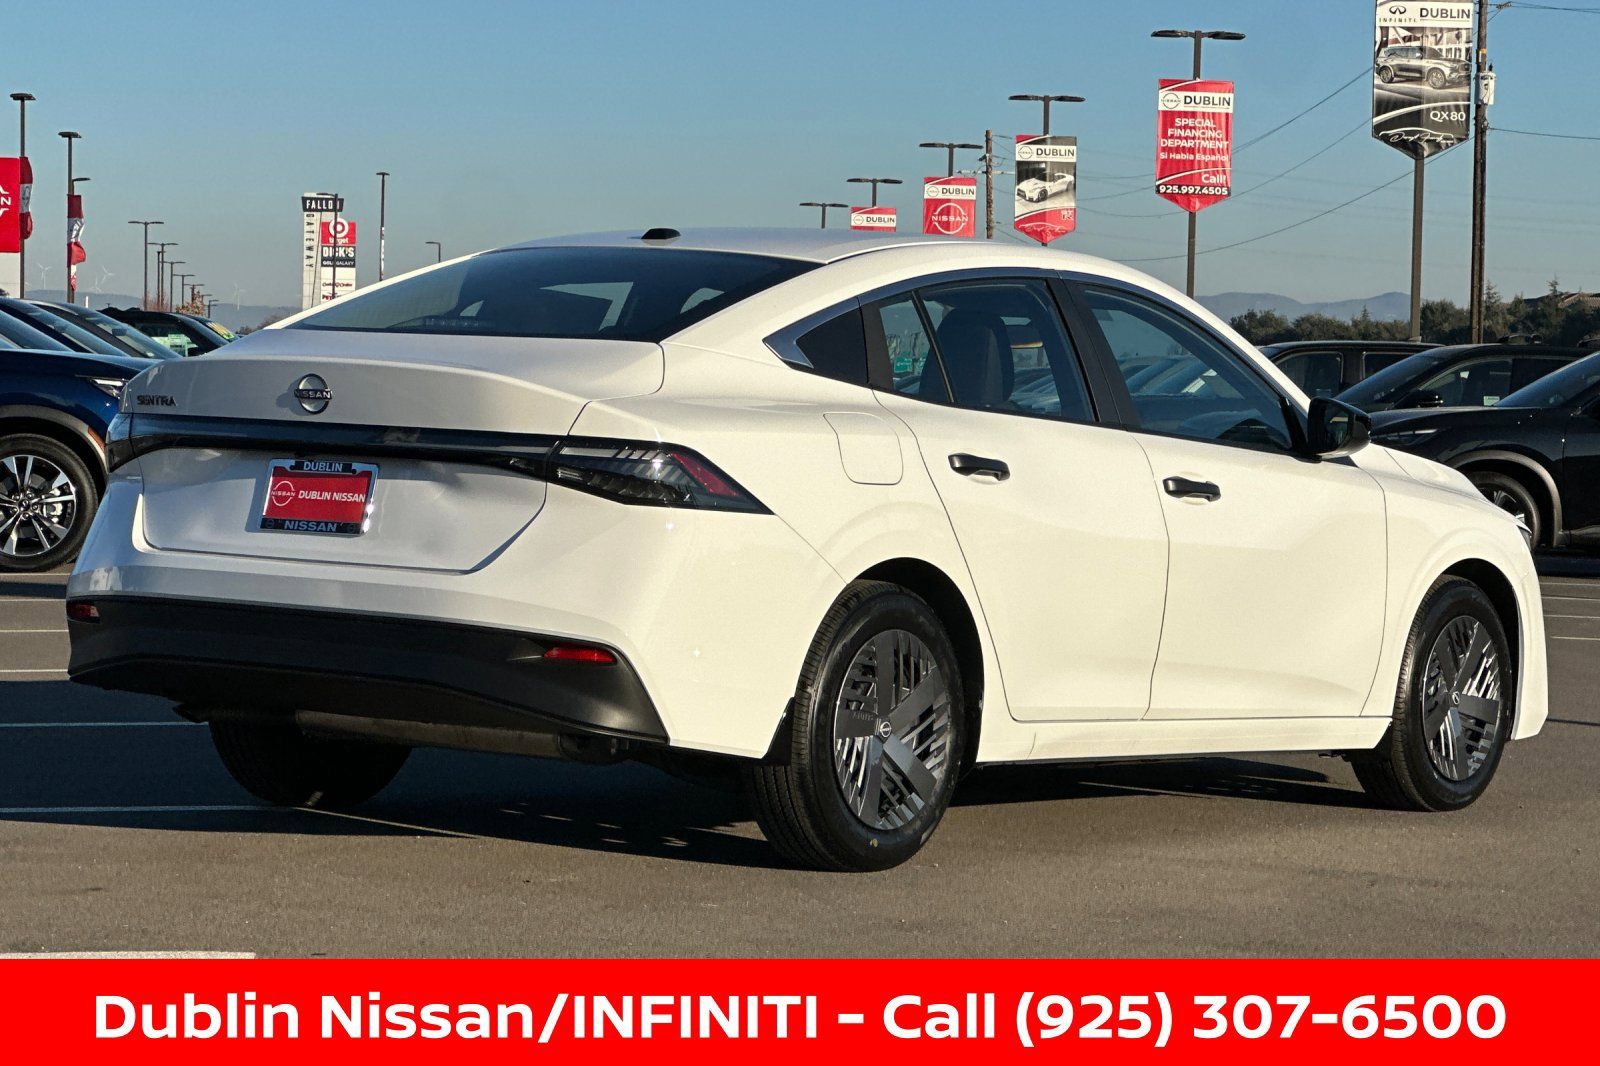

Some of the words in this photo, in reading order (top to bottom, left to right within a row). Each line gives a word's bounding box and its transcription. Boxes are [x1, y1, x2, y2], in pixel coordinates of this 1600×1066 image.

[1419, 8, 1471, 19] DUBLIN
[1183, 95, 1231, 107] DUBLIN
[1429, 110, 1466, 123] QX80
[1174, 117, 1217, 128] SPECIAL
[1167, 128, 1223, 139] FINANCING
[1160, 138, 1230, 149] DEPARTMENT
[1036, 147, 1075, 157] DUBLIN
[1169, 151, 1194, 160] Habla
[941, 187, 975, 196] DUBLIN
[1159, 184, 1228, 196] 925.997.4505
[931, 214, 969, 222] NISSAN
[136, 394, 177, 407] SENTRA
[303, 461, 343, 472] DUBLIN
[298, 490, 331, 500] DUBLIN
[332, 492, 366, 503] NISSAN
[284, 520, 337, 532] NISSAN
